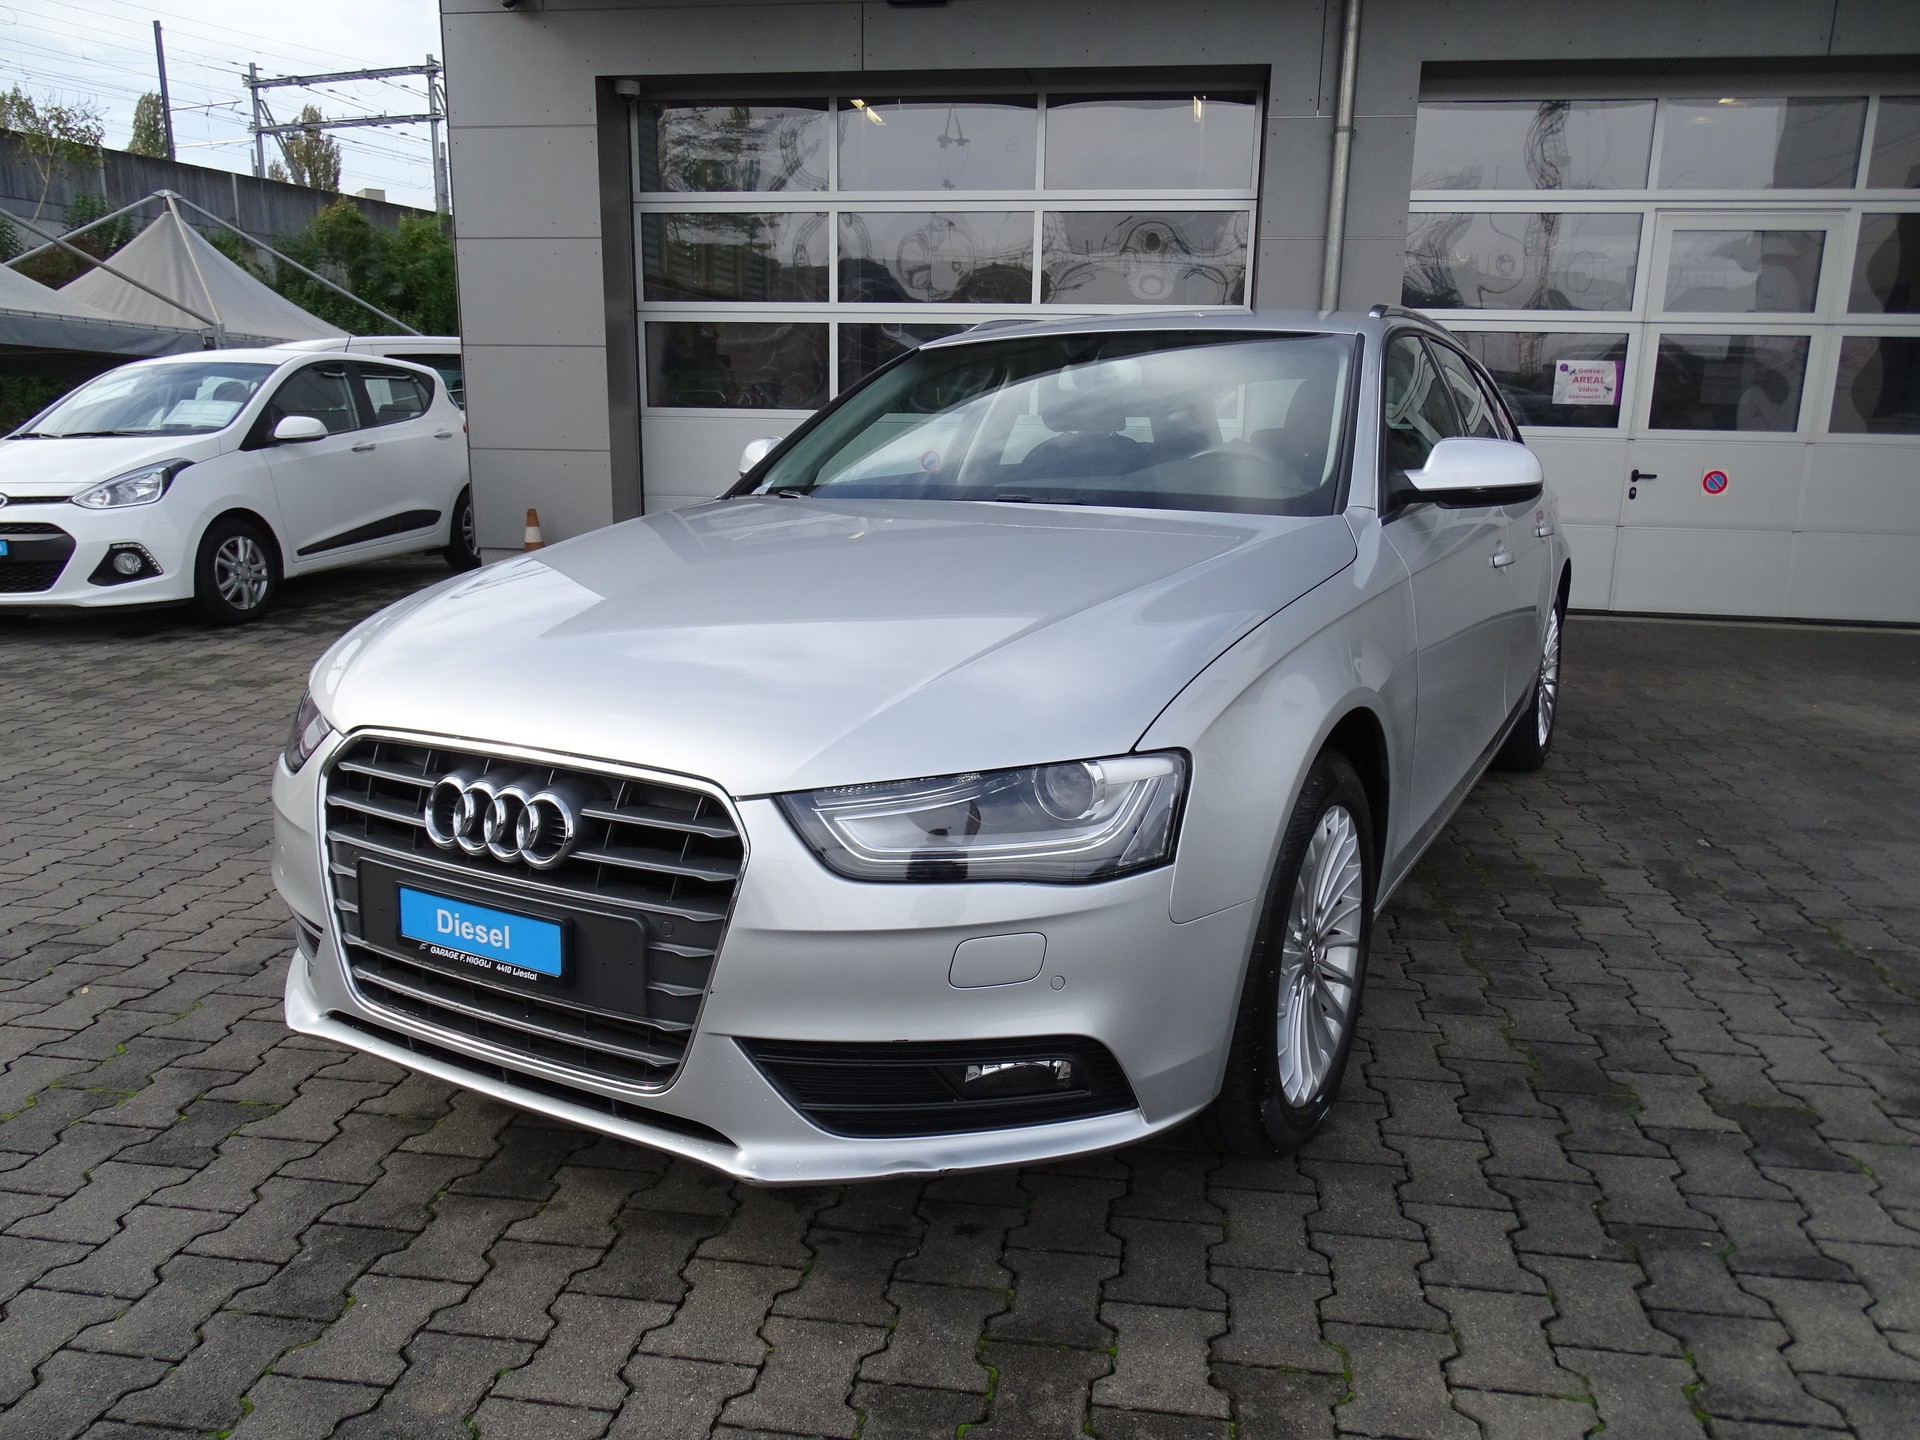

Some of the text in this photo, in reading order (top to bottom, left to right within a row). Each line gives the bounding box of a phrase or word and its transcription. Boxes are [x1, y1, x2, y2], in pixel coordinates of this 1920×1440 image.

[1572, 376, 1606, 384] AREAL
[436, 908, 510, 950] Diesel
[430, 945, 459, 960] GARAGE
[466, 955, 491, 968] NIGGLI
[496, 963, 512, 974] 4410
[512, 966, 538, 981] Liestal
